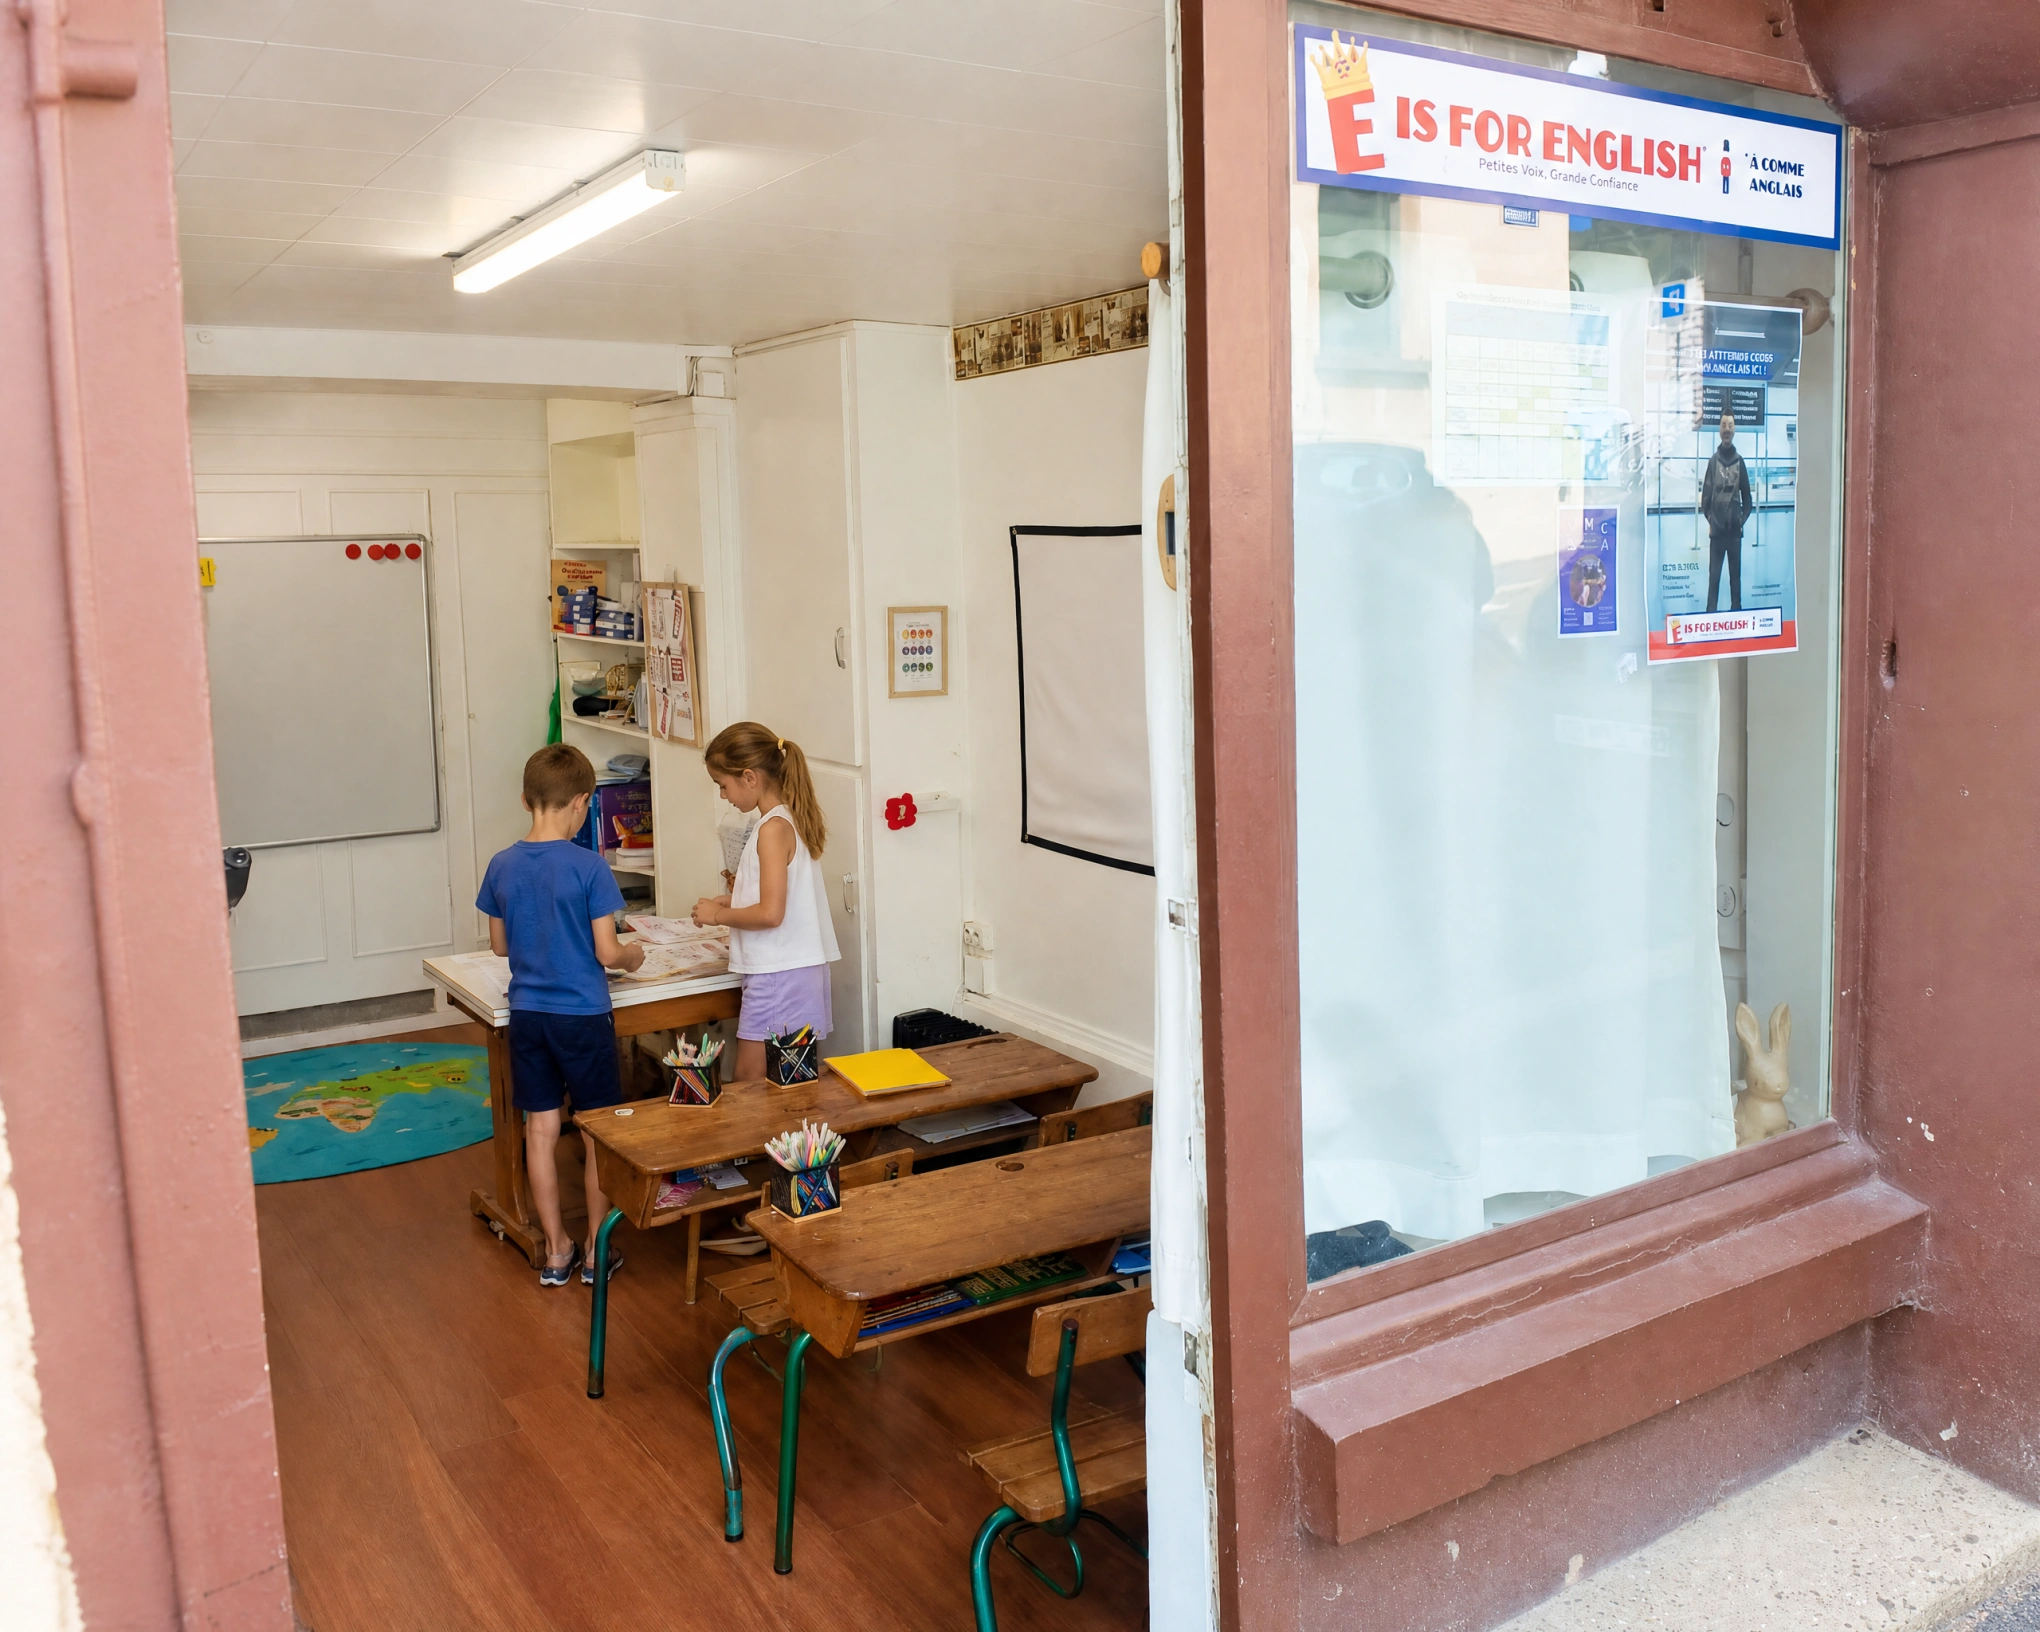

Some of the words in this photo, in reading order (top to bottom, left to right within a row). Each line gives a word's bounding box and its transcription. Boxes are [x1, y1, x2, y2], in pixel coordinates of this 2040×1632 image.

[1327, 88, 1386, 175] E
[1396, 95, 1438, 143] IS
[1449, 104, 1532, 158] FOR
[1543, 120, 1702, 184] ENGLISH
[1479, 157, 1519, 175] Petites
[1521, 163, 1548, 180] Voix,
[1550, 169, 1588, 185] Grande
[1589, 174, 1639, 192] Confiance
[1761, 157, 1805, 177] COMME
[1749, 177, 1803, 198] ANGLAIS
[1684, 622, 1694, 634] IS
[1713, 619, 1749, 632] ENGLISH
